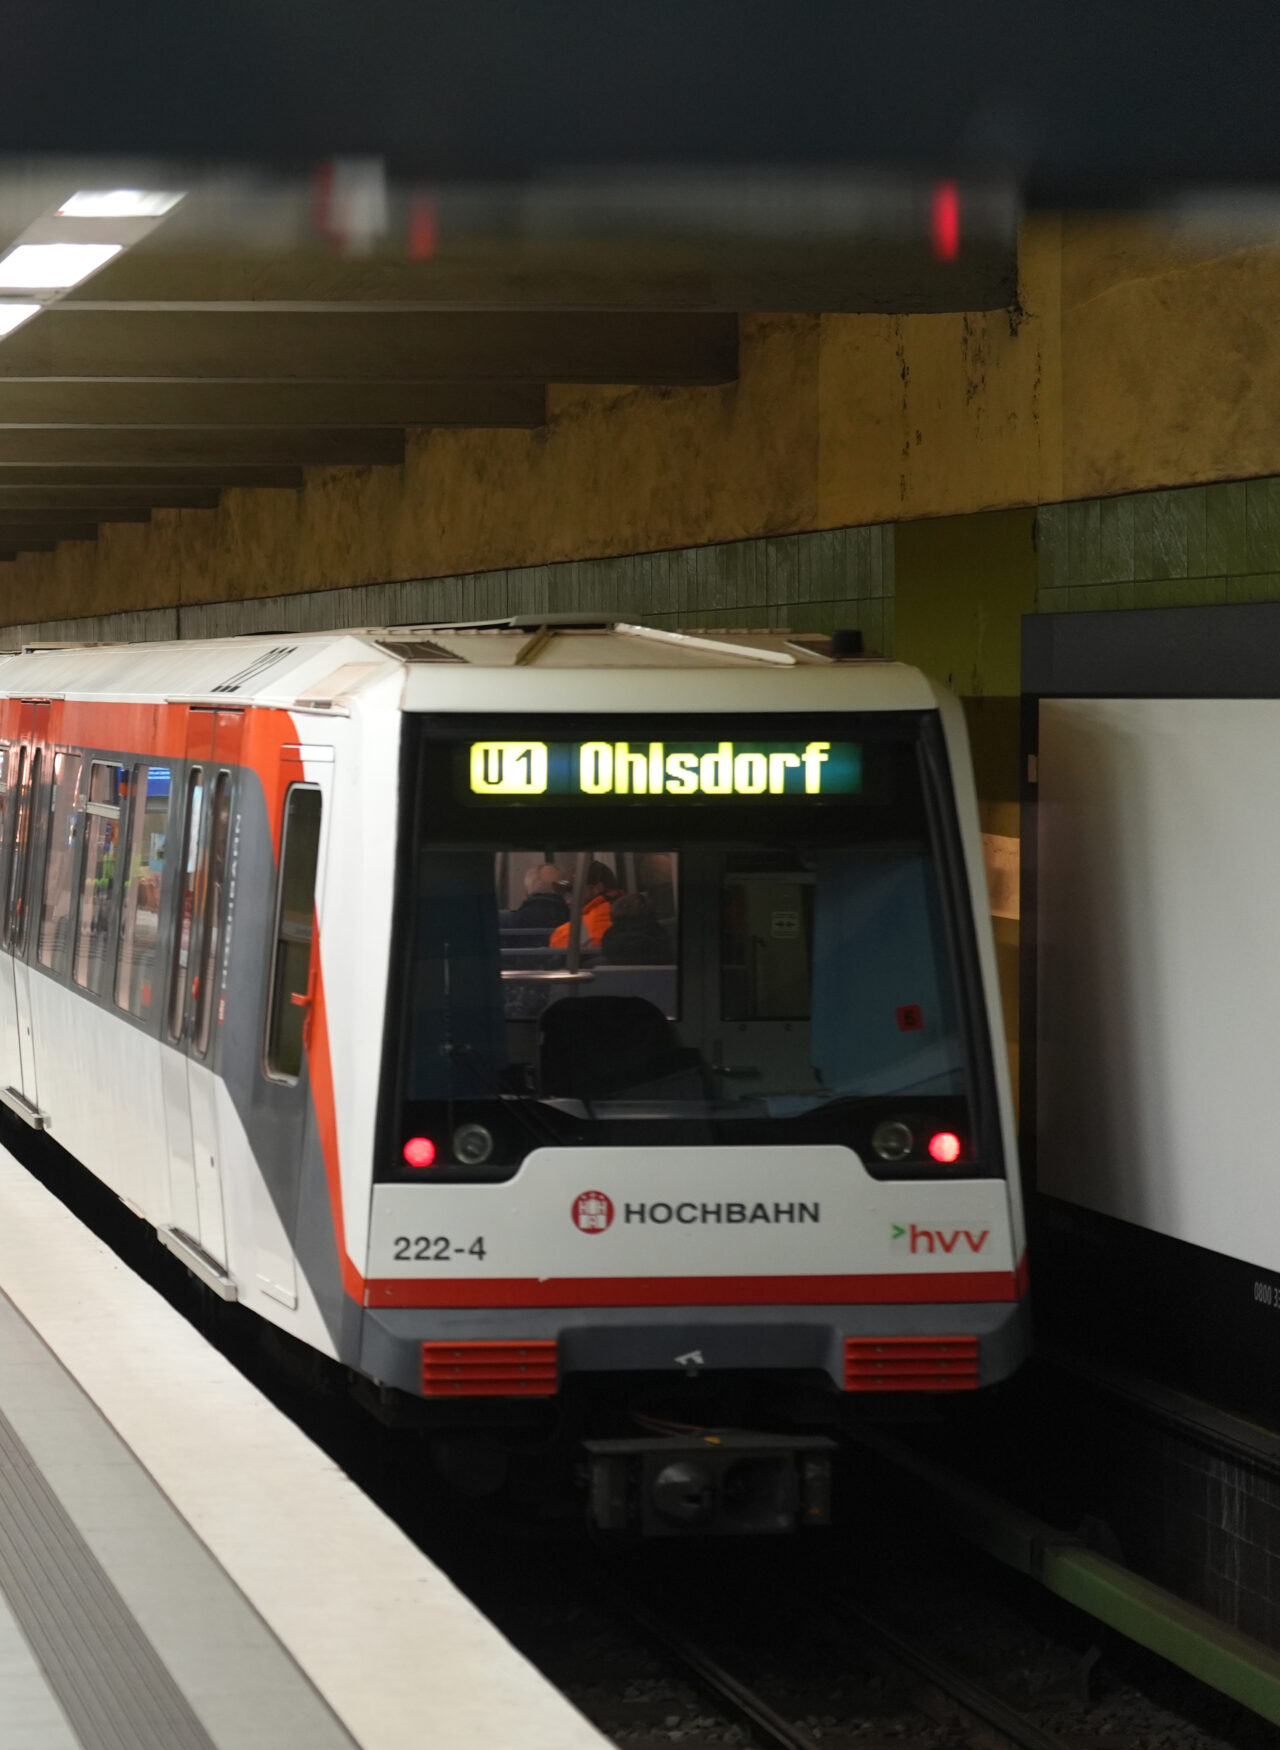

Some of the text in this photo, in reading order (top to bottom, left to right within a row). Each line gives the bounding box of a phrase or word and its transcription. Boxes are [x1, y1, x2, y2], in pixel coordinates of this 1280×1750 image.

[483, 749, 532, 785] U1
[579, 742, 831, 794] Ohlsdorf
[624, 1202, 821, 1226] HOCHBAHN
[394, 1236, 487, 1261] 222-4
[910, 1224, 989, 1254] hvv
[1254, 1281, 1272, 1305] 0800
